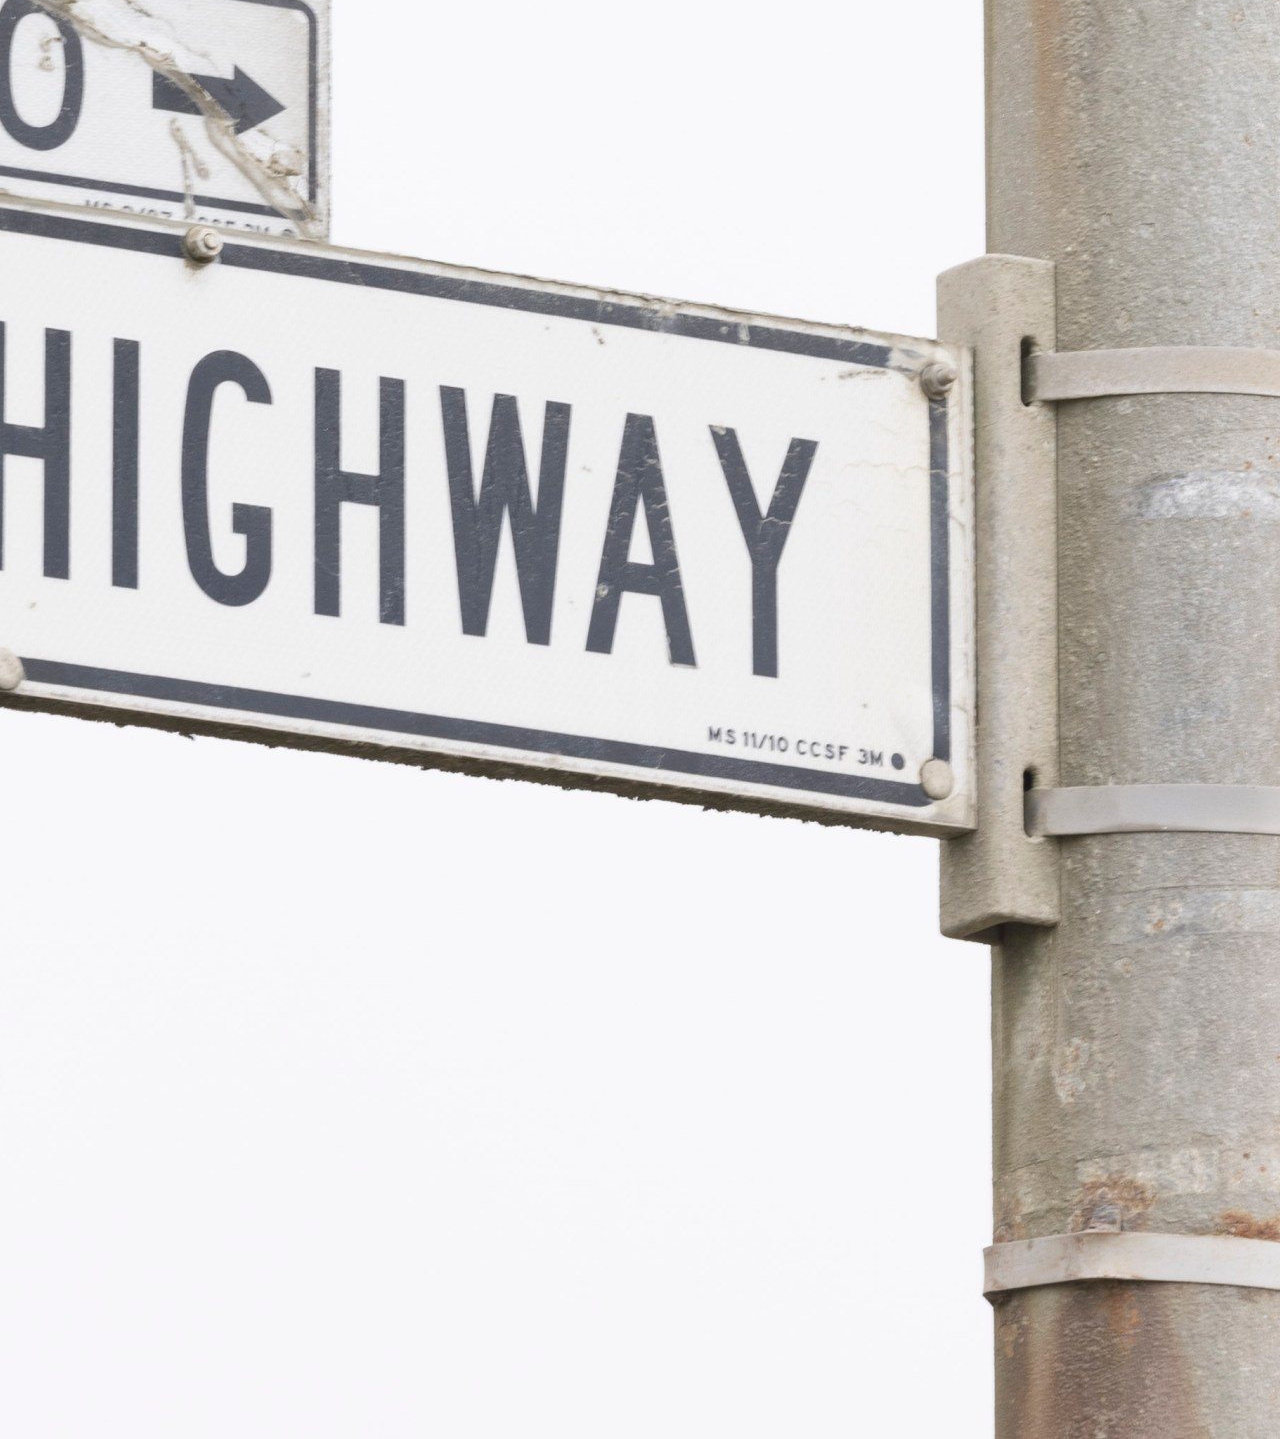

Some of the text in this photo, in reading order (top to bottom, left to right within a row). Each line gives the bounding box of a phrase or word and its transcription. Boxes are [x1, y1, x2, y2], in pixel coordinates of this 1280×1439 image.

[742, 731, 789, 753] 11/10
[796, 738, 850, 761] CCSF
[858, 748, 885, 767] 3M
